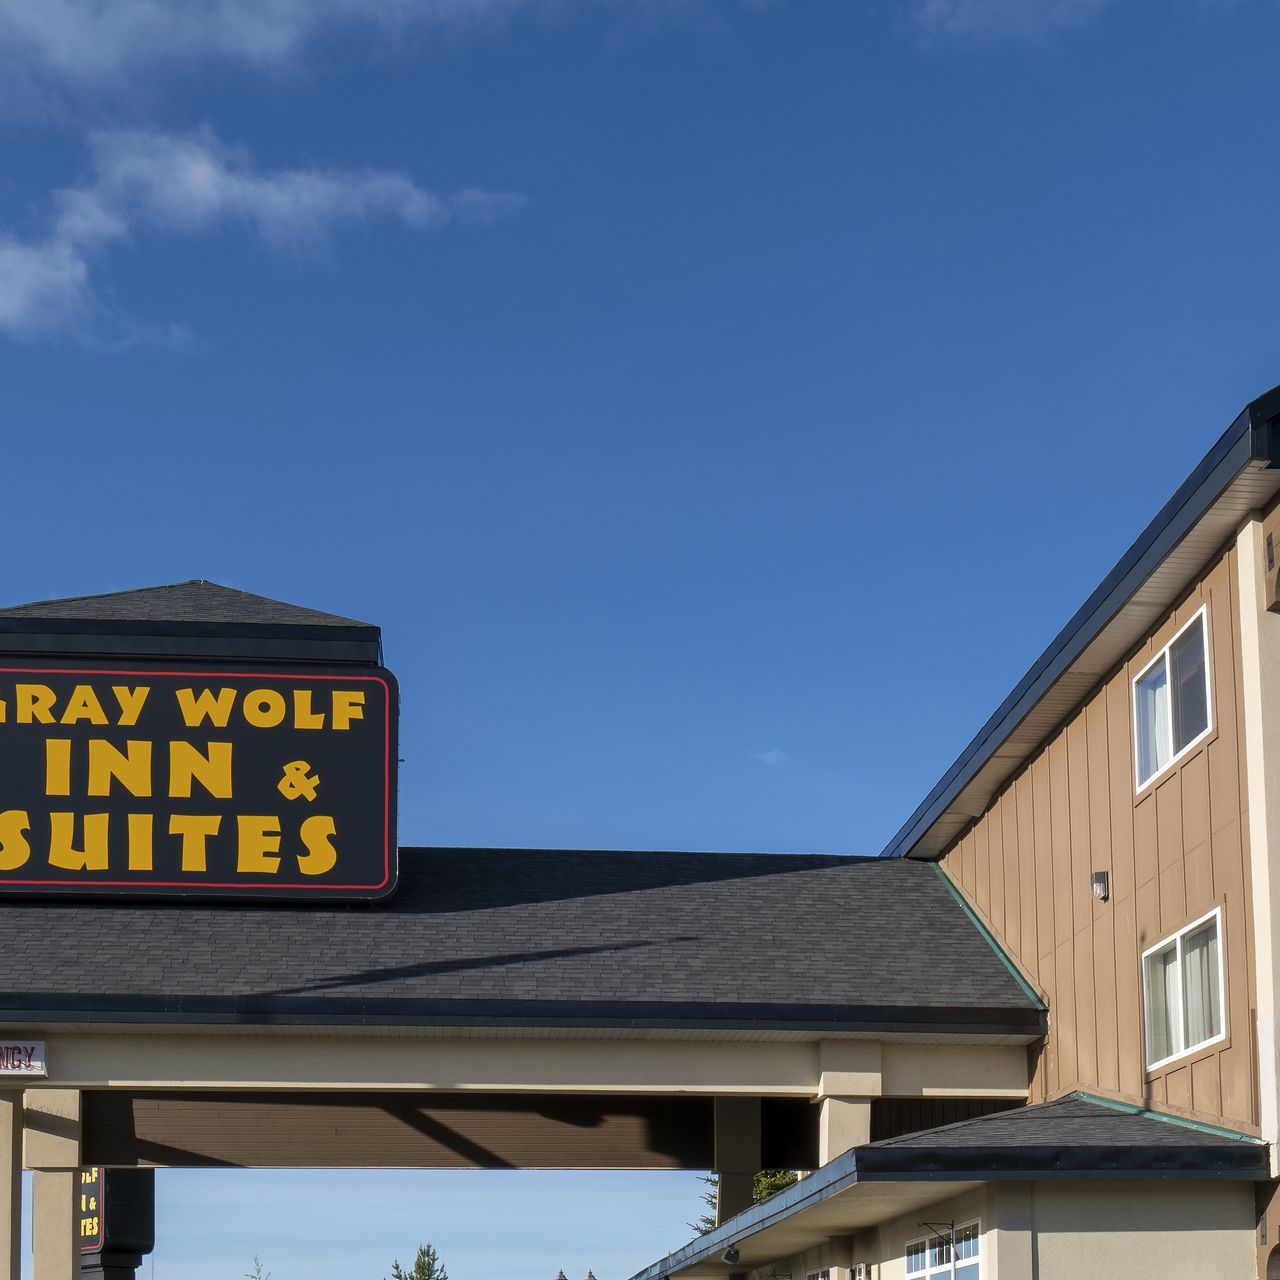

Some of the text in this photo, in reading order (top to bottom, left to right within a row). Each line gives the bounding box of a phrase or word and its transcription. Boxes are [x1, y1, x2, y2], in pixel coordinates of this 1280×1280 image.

[176, 688, 365, 730] WOLF
[46, 739, 320, 800] INN &
